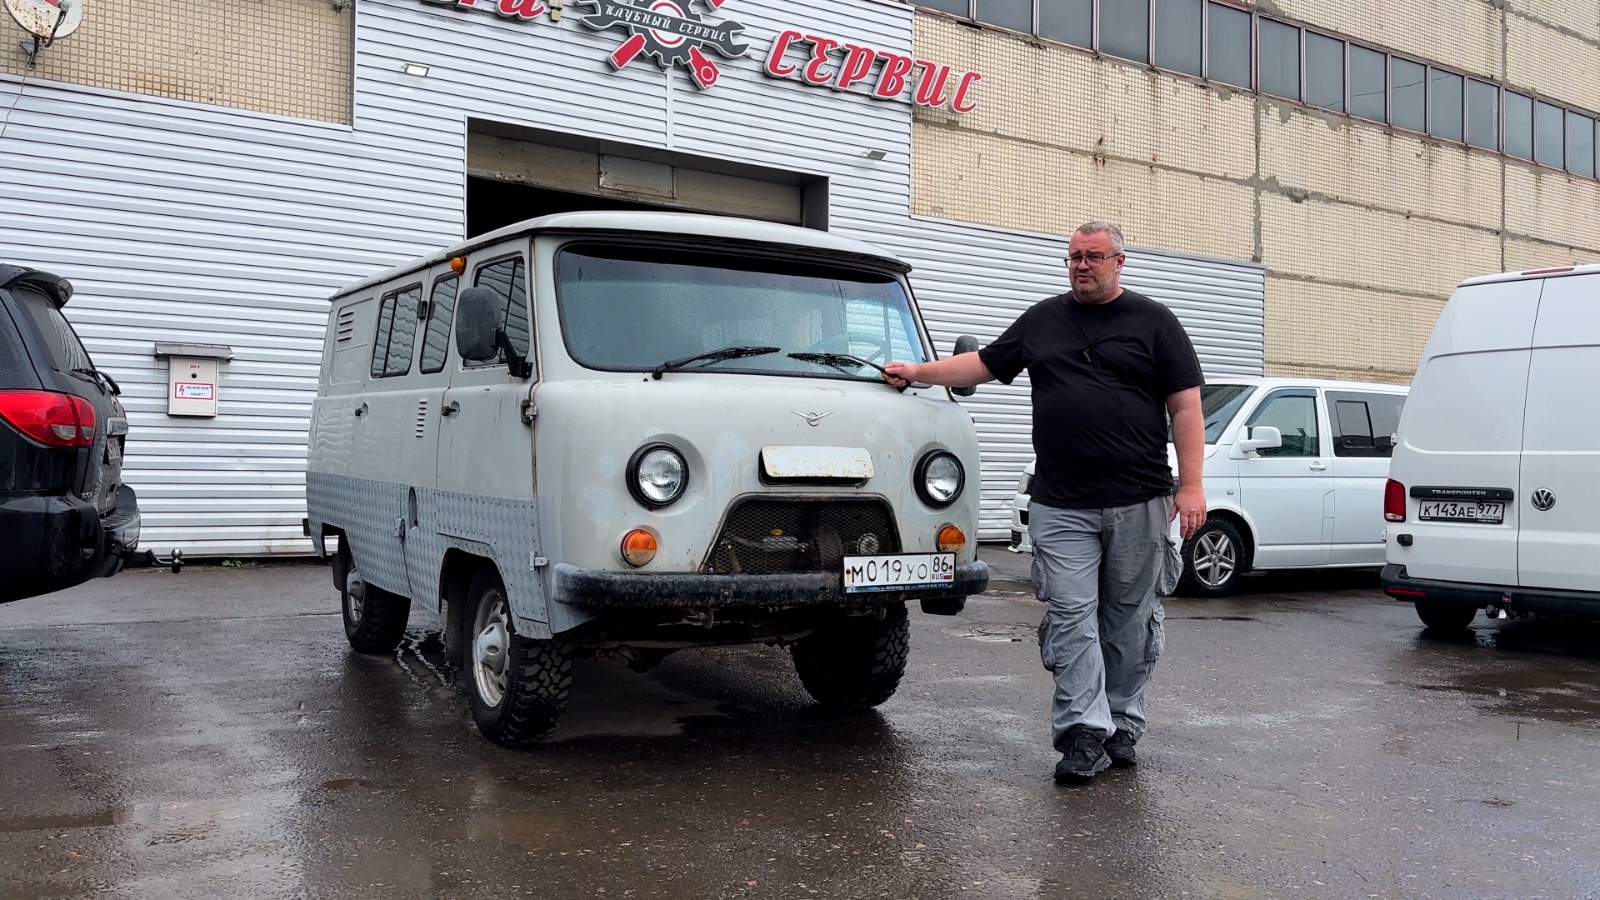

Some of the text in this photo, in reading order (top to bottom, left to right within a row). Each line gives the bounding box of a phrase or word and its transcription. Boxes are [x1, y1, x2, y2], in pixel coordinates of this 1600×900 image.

[605, 4, 726, 42] КЛУБНЫЙ СЕРВИС
[765, 30, 983, 113] СЕРВИС
[1478, 503, 1500, 515] 977
[932, 556, 949, 573] 86
[931, 572, 944, 580] RUS
